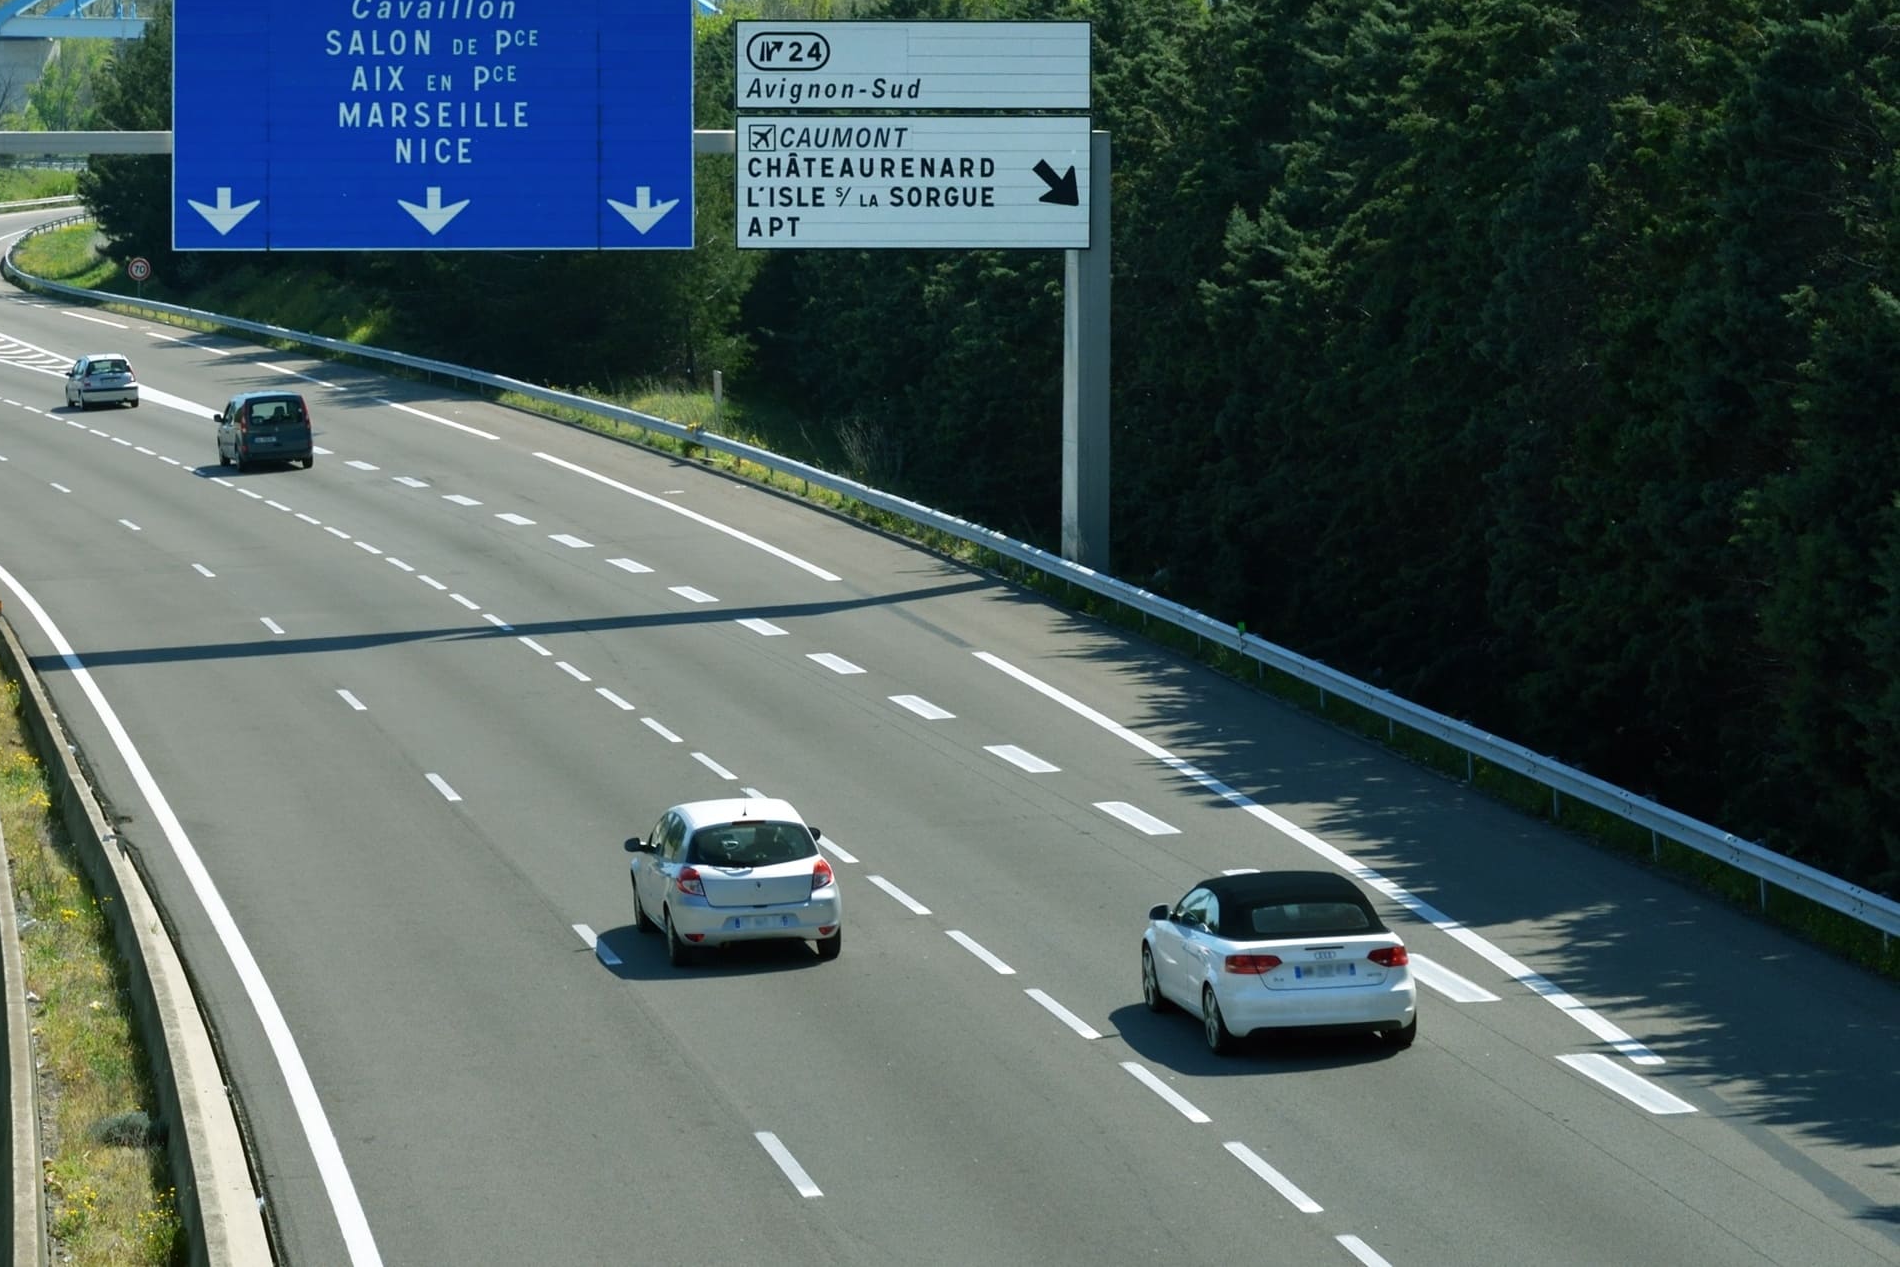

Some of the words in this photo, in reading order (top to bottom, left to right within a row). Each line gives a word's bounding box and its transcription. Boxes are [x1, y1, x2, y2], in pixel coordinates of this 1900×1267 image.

[326, 29, 430, 55] SALON
[453, 38, 477, 55] DE
[789, 42, 822, 61] 24
[351, 66, 404, 91] AIX
[427, 75, 451, 91] EN
[747, 78, 921, 103] Avignon-Sud
[339, 102, 528, 127] MARSEILLE
[780, 127, 908, 148] CAUMONT
[396, 138, 471, 163] NICE
[748, 153, 995, 178] CHÂTEAURENARD
[748, 187, 825, 207] L'ISLE
[860, 194, 879, 207] LA
[890, 187, 995, 207] SORGUE
[748, 217, 801, 237] APT
